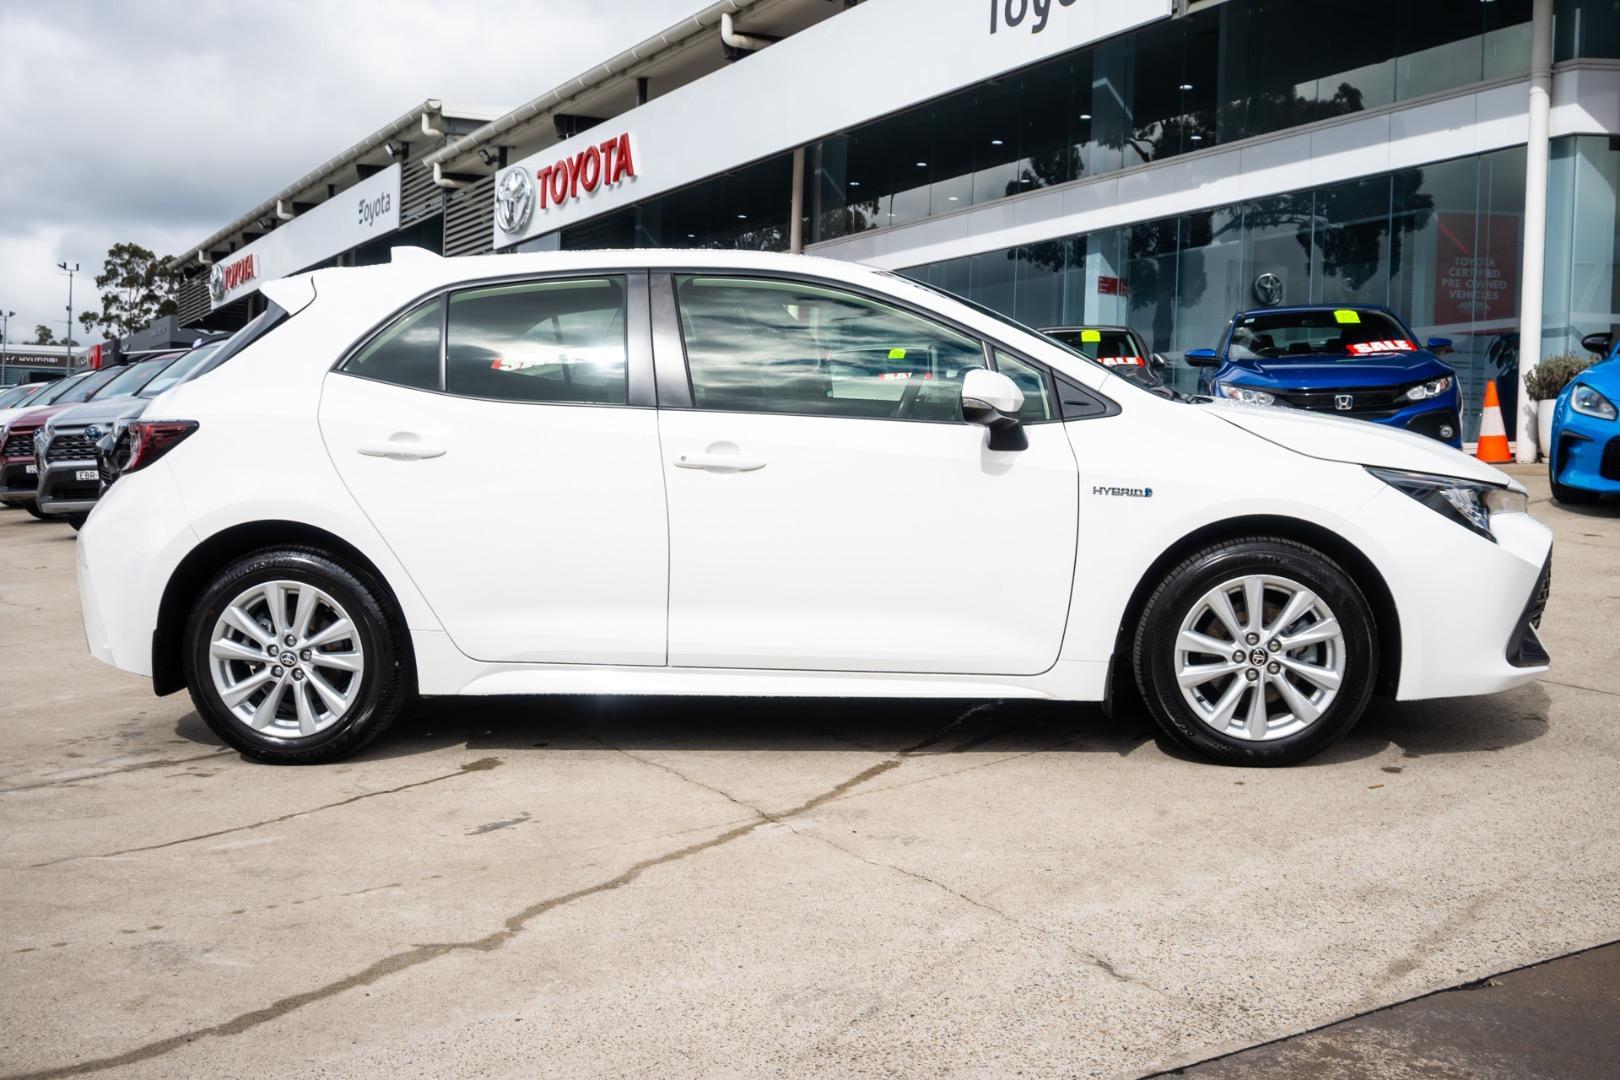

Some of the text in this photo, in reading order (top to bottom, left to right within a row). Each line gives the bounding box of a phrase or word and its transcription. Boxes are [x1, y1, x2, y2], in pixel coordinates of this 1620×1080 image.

[990, 0, 1078, 34] oy
[537, 132, 634, 209] TOYOTA
[1454, 257, 1496, 267] TOYOTA
[224, 253, 254, 291] TOYOTA
[1448, 267, 1501, 278] CERTIFIED
[1449, 289, 1499, 300] VEHICLES
[1353, 339, 1414, 353] SALE
[1093, 486, 1143, 497] HYBRID
